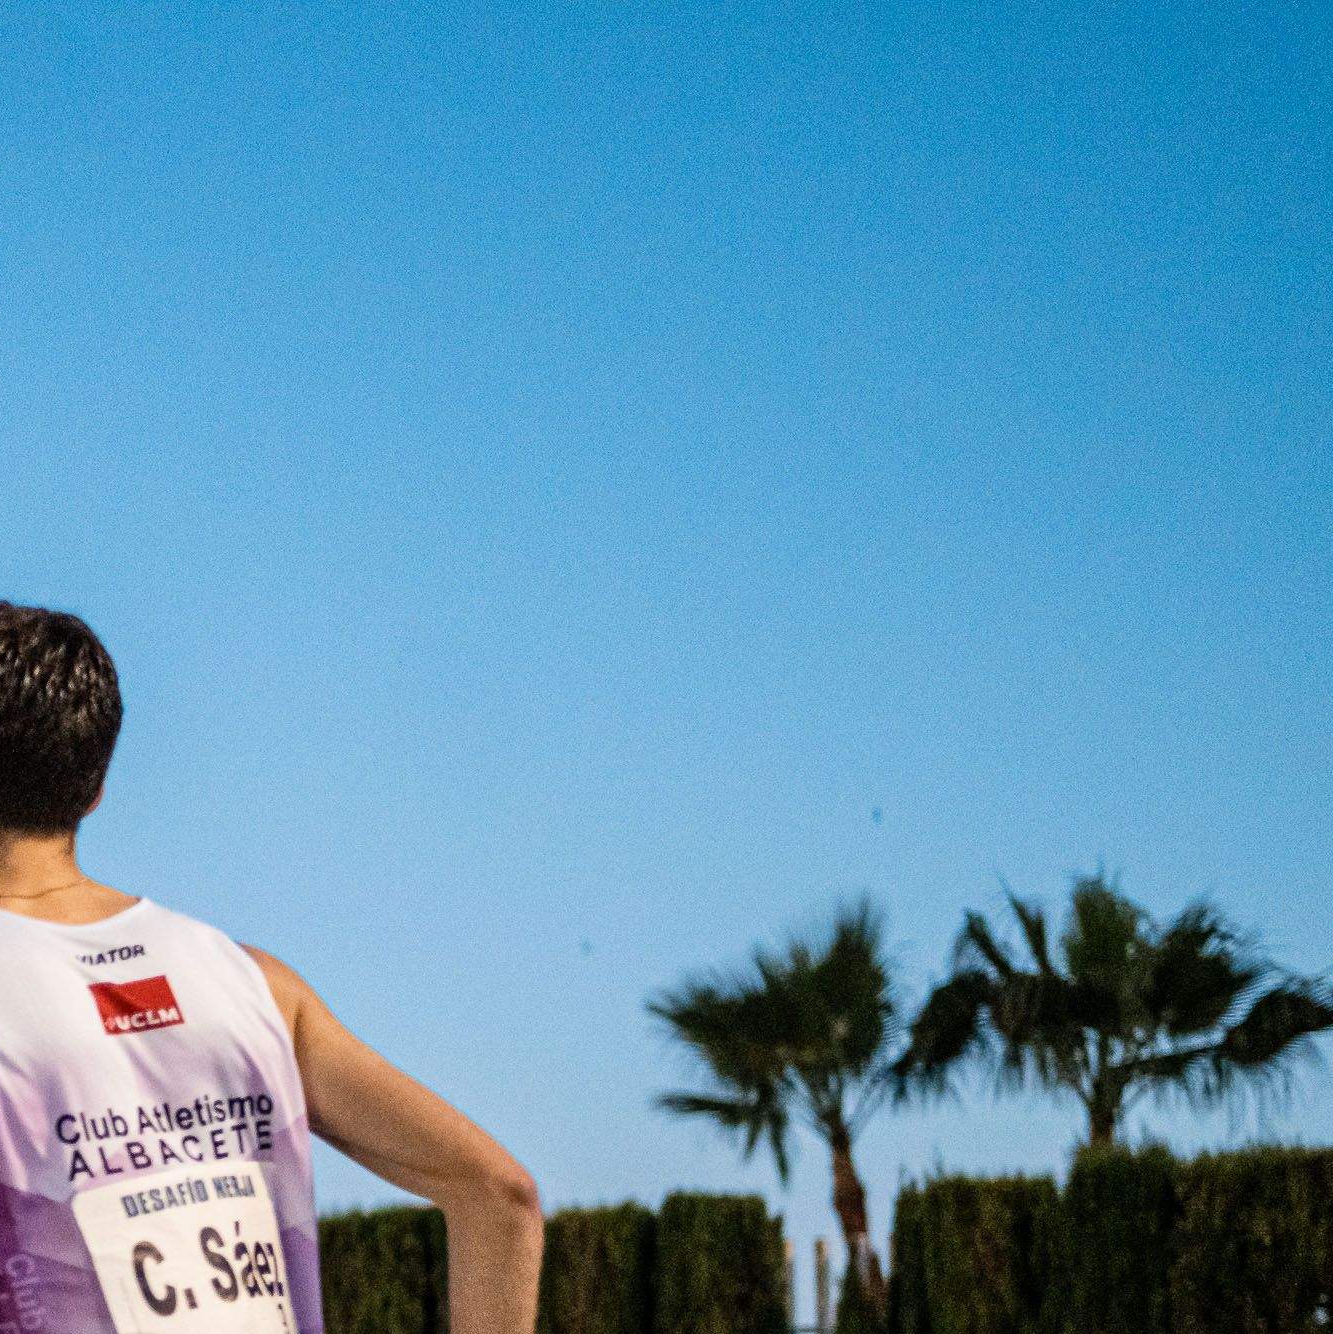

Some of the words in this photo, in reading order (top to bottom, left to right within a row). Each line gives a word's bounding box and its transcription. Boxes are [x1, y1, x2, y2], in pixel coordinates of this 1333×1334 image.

[55, 1108, 129, 1144] Club
[137, 1094, 273, 1135] Atletismo
[68, 1120, 273, 1182] ALBACETE
[132, 1240, 198, 1317] C.
